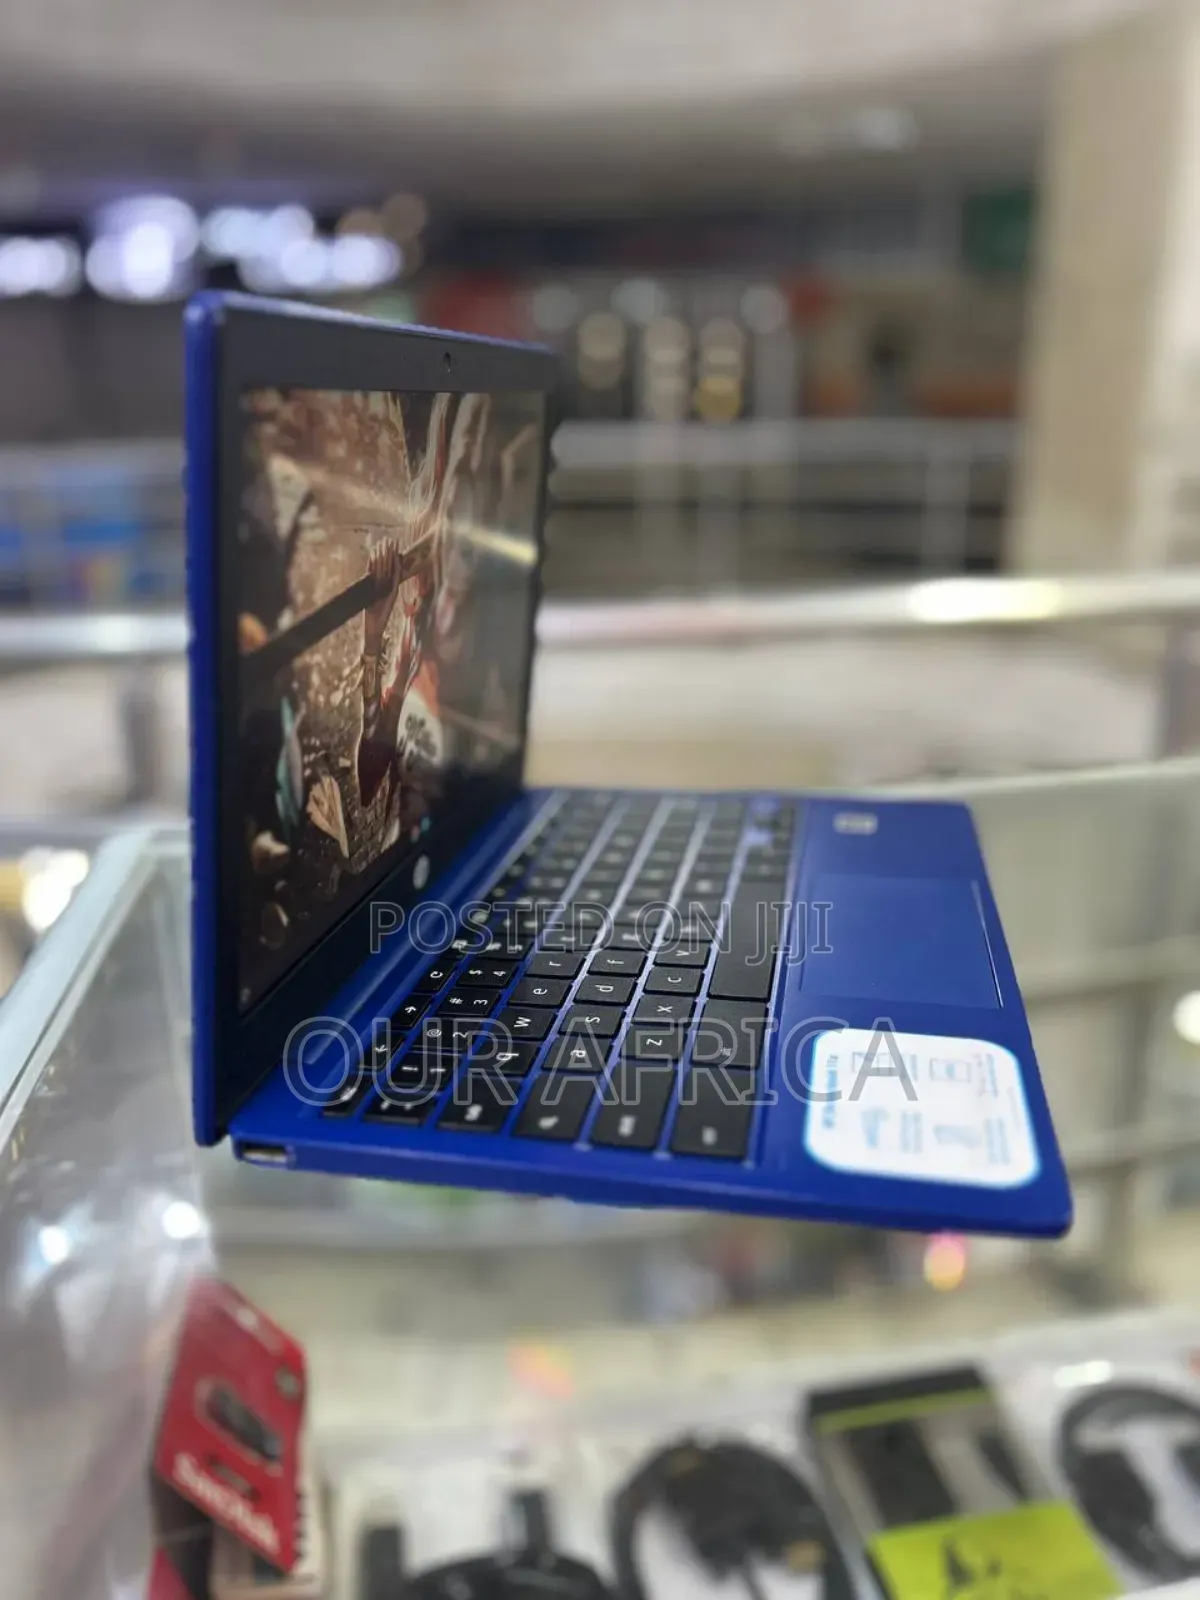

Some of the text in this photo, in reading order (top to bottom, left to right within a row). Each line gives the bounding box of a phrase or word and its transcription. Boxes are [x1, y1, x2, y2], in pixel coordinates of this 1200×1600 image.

[595, 984, 614, 993] d
[449, 997, 463, 1005] #
[657, 1005, 673, 1013] x
[513, 1016, 531, 1028] w
[427, 1029, 442, 1037] @
[646, 1038, 663, 1046] z
[496, 1052, 519, 1062] q
[570, 1049, 587, 1058] a
